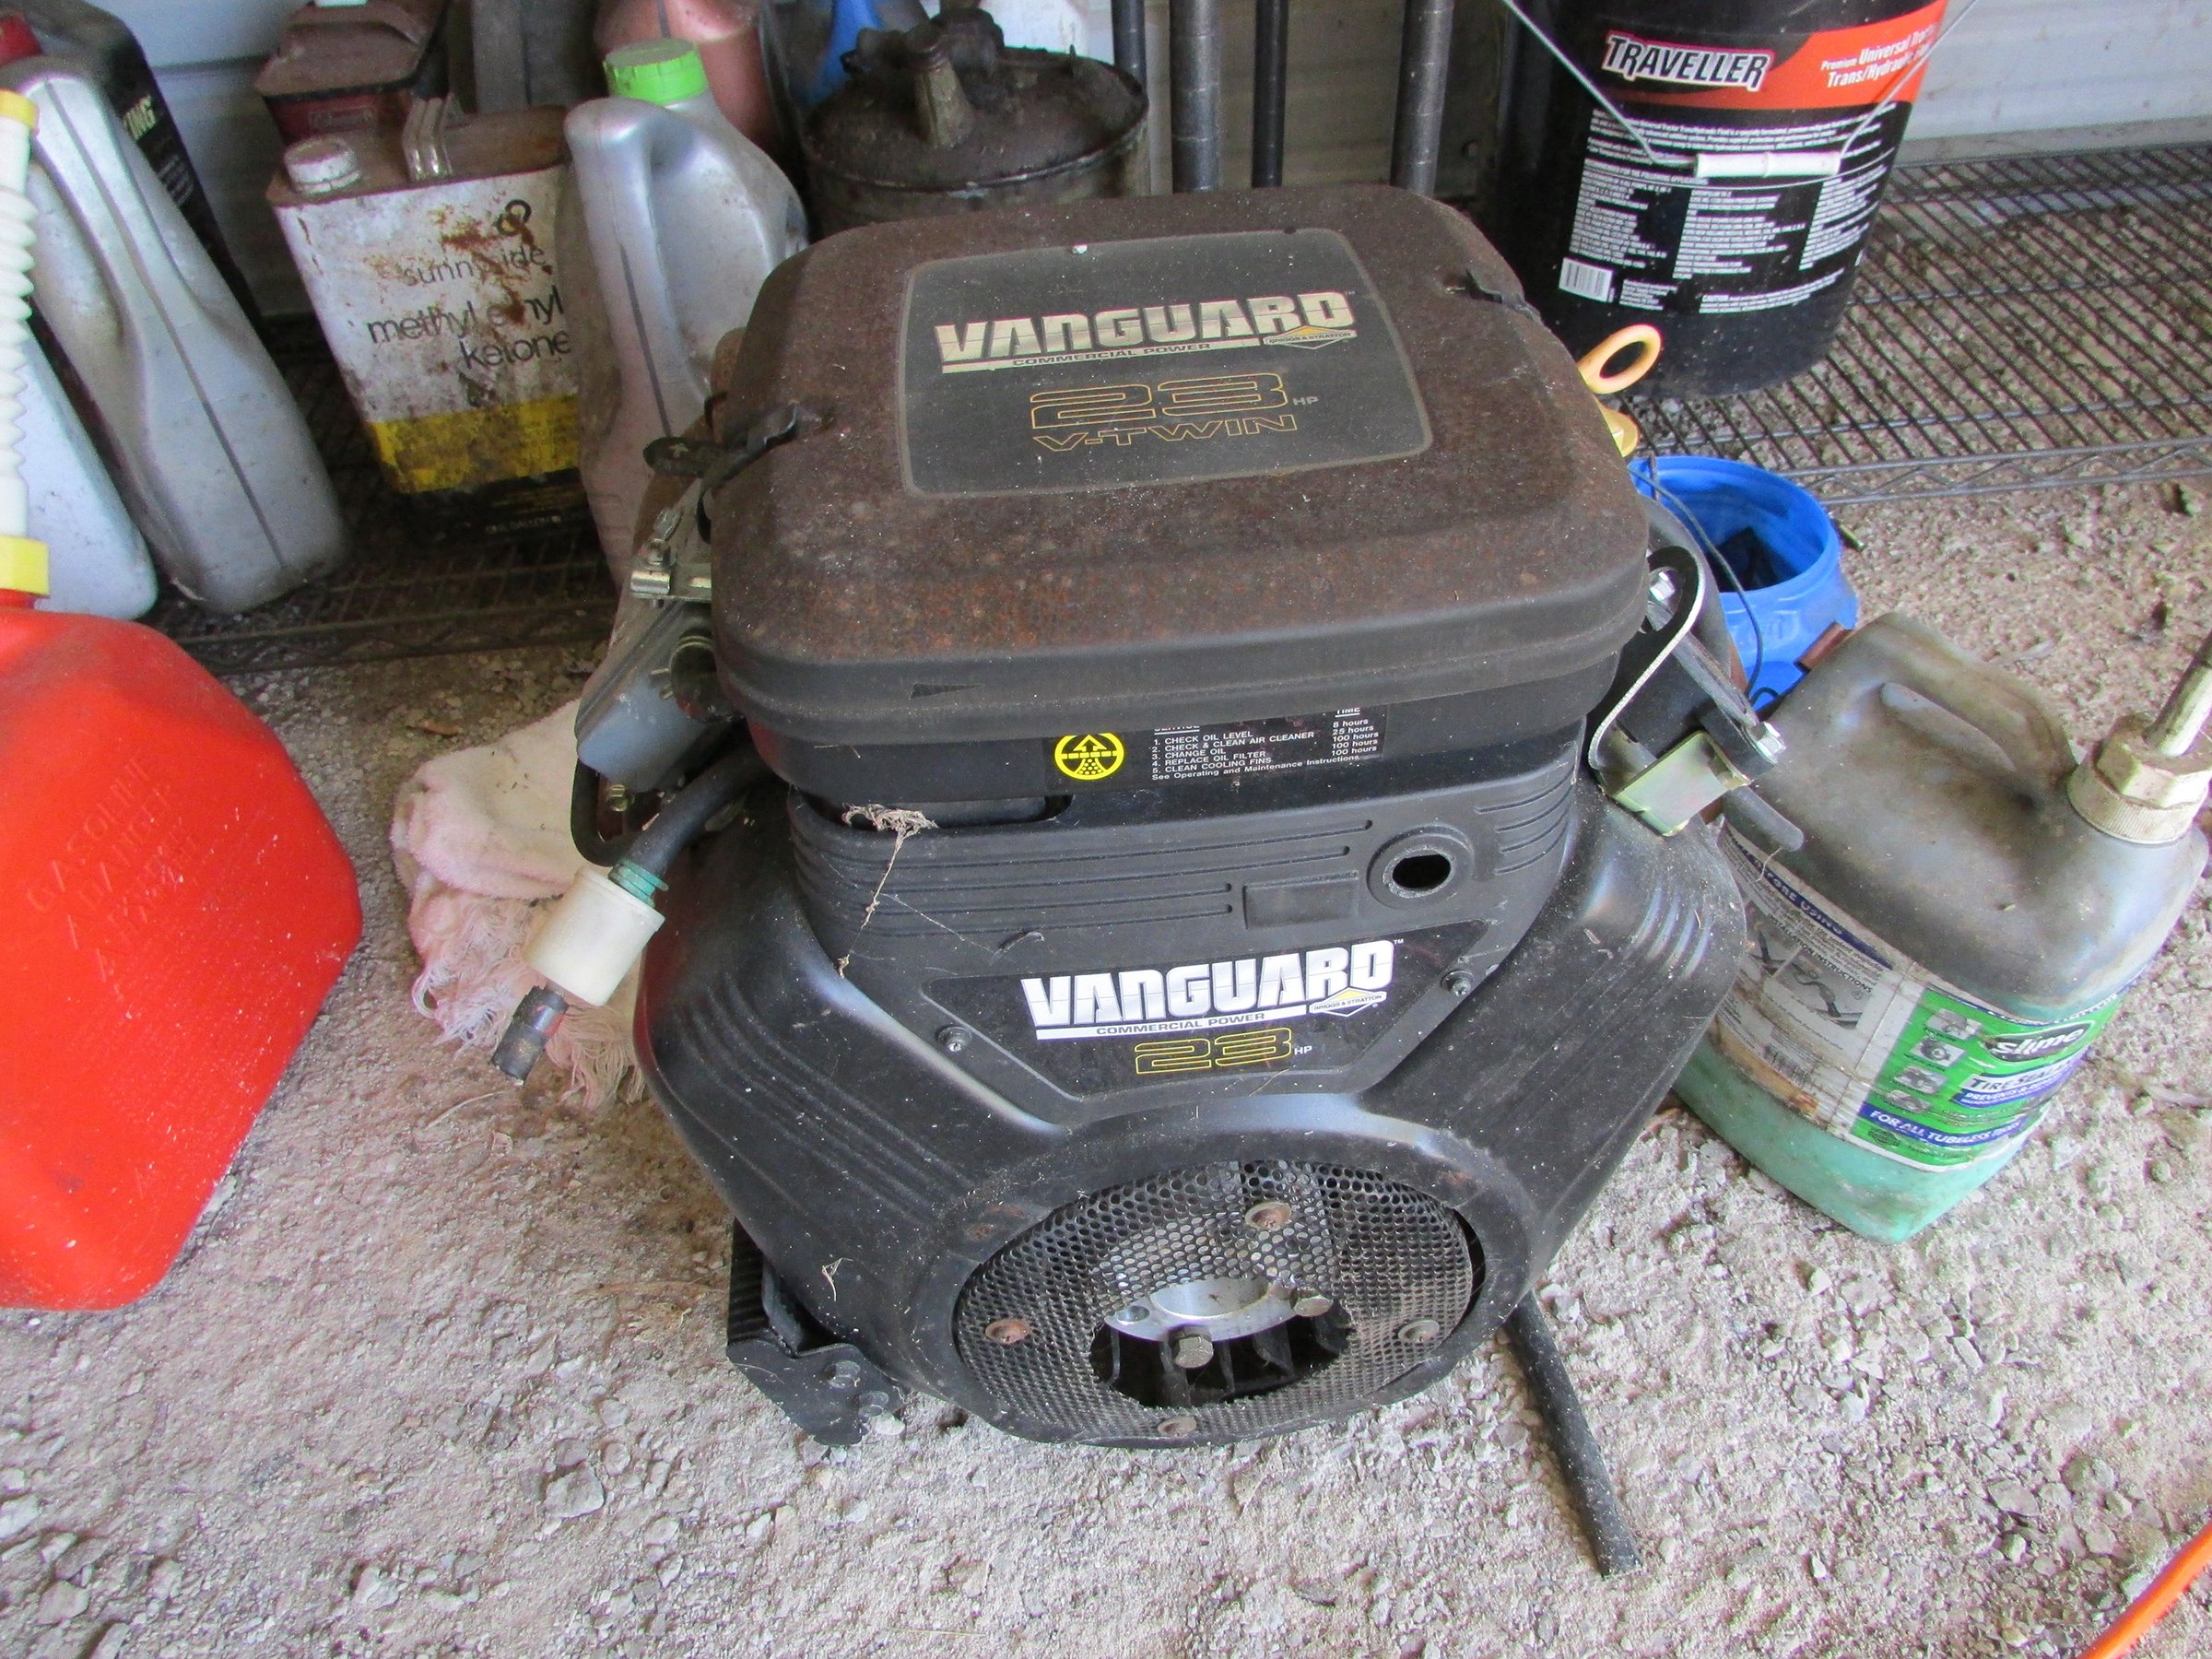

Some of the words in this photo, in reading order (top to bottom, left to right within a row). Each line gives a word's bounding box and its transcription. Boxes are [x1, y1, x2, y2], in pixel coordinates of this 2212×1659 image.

[1604, 34, 1771, 90] TRAVELLER
[1820, 57, 1857, 71] Premium
[1858, 34, 1912, 65] Universal
[403, 244, 546, 287] sunnide
[367, 300, 477, 344] methyl
[486, 285, 565, 325] eyl
[935, 290, 1356, 361] VANGUARD
[1013, 348, 1136, 367] COMMERCIAL
[1143, 342, 1211, 355] POWER
[1030, 372, 1288, 429] 23
[1292, 396, 1319, 406] HP
[1032, 414, 1298, 453] V-TWIN
[1332, 728, 1345, 736] 25
[1347, 725, 1374, 734] hours
[1342, 719, 1369, 727] hours
[1164, 735, 1199, 745] CHECK
[1223, 731, 1253, 740] LEVEL
[1164, 743, 1199, 752] CHECK
[1213, 739, 1245, 747] CLEAN
[1249, 736, 1265, 745] AIR
[1269, 731, 1314, 743] CLEANER
[1332, 742, 1349, 750] 100
[1351, 738, 1378, 747] hours
[1352, 732, 1379, 740] hours
[1164, 748, 1206, 759] CHANGE
[1209, 747, 1226, 756] OIL
[1164, 756, 1209, 767] REPLACE
[1233, 750, 1266, 760] FILTER
[1331, 748, 1348, 757] 100
[1351, 745, 1377, 754] hours
[1165, 764, 1197, 773] CLEAN
[1201, 759, 1245, 770] COOLING
[1249, 757, 1272, 765] FINS
[1173, 768, 1219, 780] Operating
[1244, 760, 1302, 772] Maintenance
[1306, 755, 1359, 766] Instructions
[1020, 939, 1394, 1026] VANGUARD
[1813, 949, 1874, 994] INSTRUCTIONS
[1347, 994, 1382, 1006] STRATTON
[1096, 1021, 1202, 1035] COMMERCIAL
[1208, 1013, 1265, 1026] POWER
[1135, 1028, 1291, 1075] 23
[1294, 1045, 1312, 1055] HP
[1991, 1028, 2086, 1055] slime
[1870, 1109, 1900, 1127] FOR
[1899, 1123, 1924, 1136] ALL
